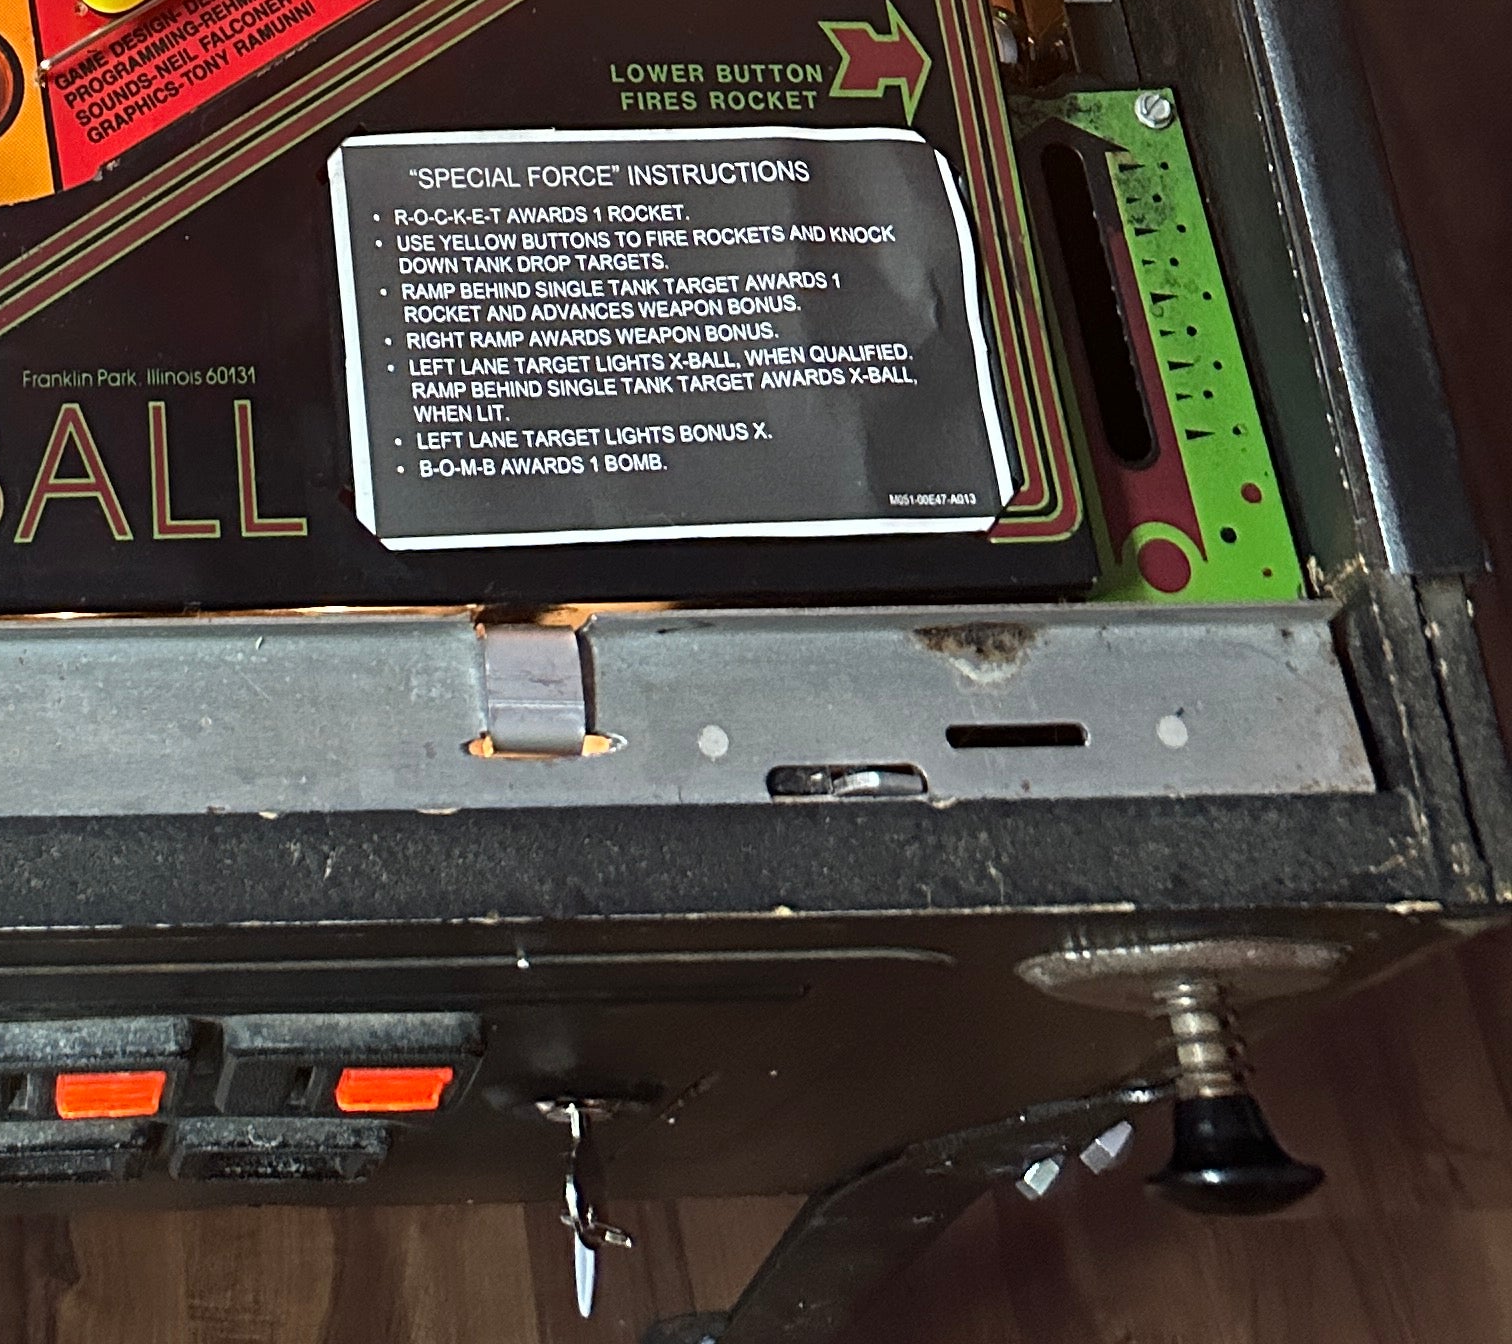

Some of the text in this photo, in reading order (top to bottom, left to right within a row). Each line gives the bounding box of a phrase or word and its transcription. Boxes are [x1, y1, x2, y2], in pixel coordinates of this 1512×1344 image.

[54, 50, 110, 92] GAME
[108, 10, 181, 57] DESIGN-
[86, 0, 317, 145] GRAPHICS-TONY RAMUNNI
[609, 62, 824, 85] LOWER BUTTON
[74, 46, 199, 128] SOUNDS-NEIL
[620, 89, 818, 112] FIRES ROCKET
[626, 159, 810, 186] INSTRUCTIONS
[393, 202, 690, 226] R-O-C-K-E-T AWARDS 1 ROCKET.
[395, 223, 896, 252] USE YELLOW BUTTONS TO FIRE ROCKETS AND KNOCK
[397, 251, 670, 275] DOWN TANK DROP TARGETS.
[22, 369, 94, 388] Franklin
[147, 368, 202, 386] Illinois
[206, 366, 257, 386] 60131
[418, 452, 668, 478] B-O-M-B AWARDS 1 BOMB.
